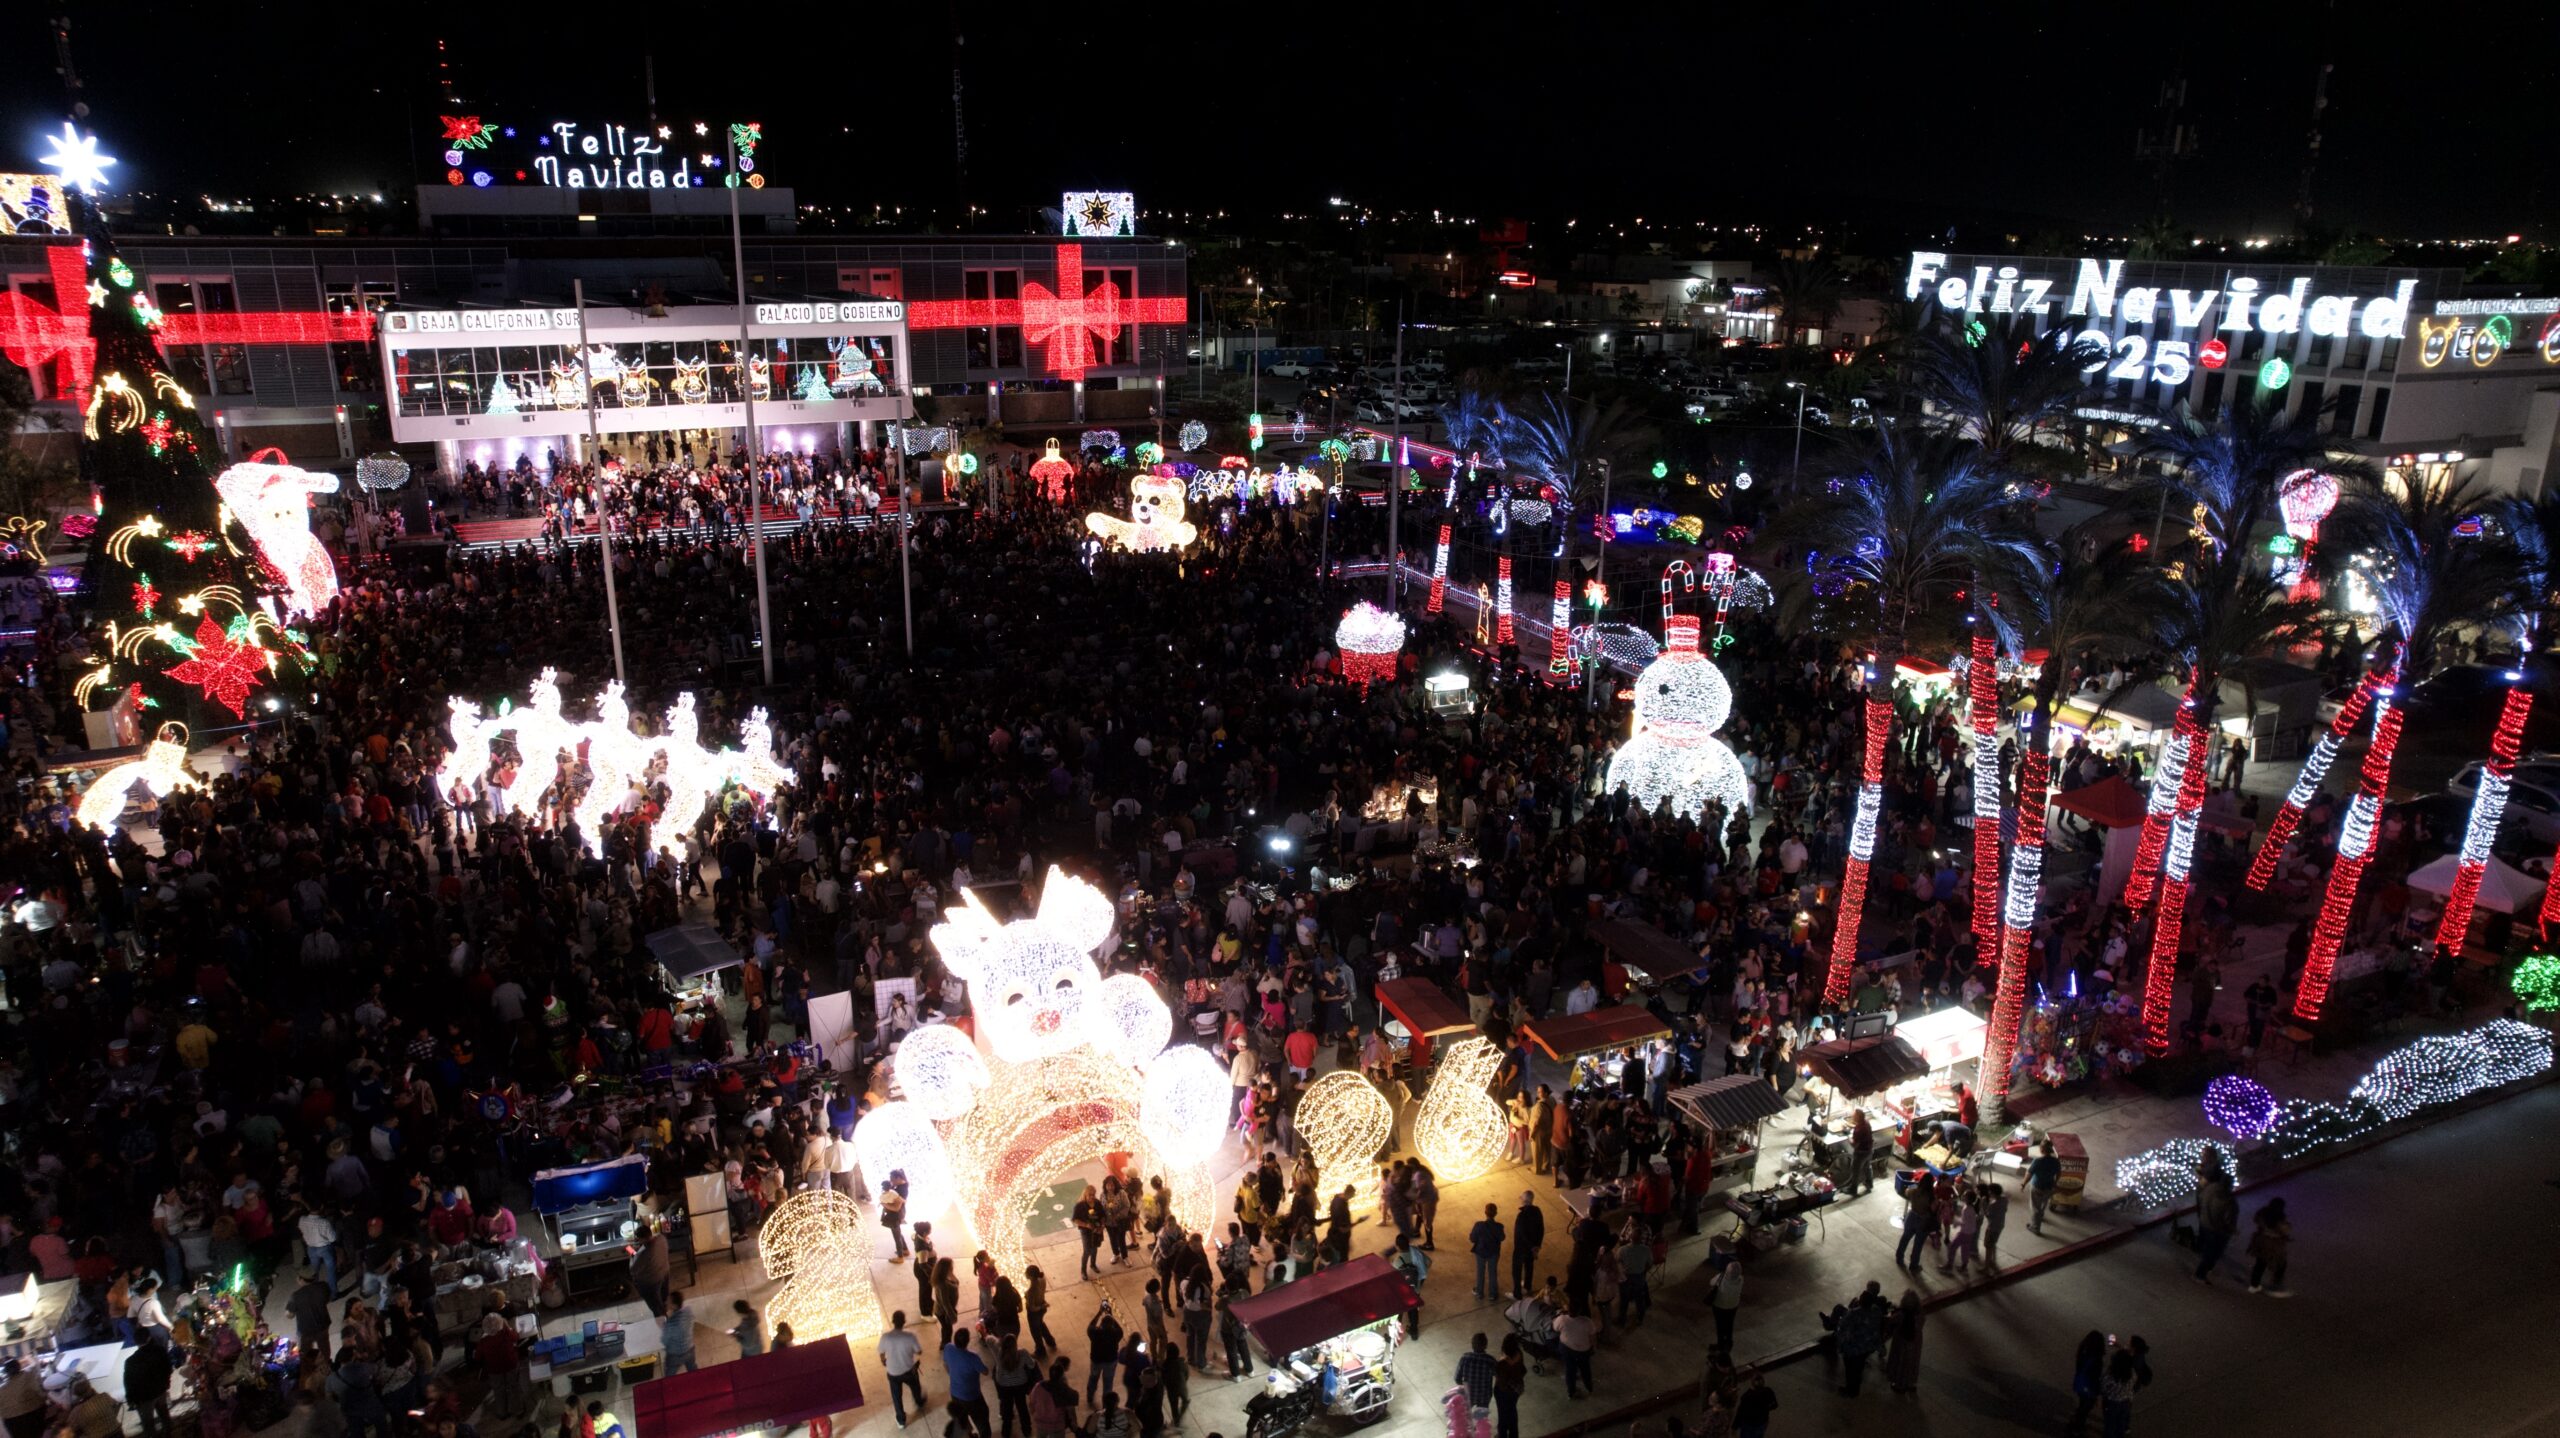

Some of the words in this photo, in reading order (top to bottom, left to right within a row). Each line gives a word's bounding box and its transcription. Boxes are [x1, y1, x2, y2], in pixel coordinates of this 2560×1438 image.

[552, 121, 663, 156] Feliz
[534, 156, 690, 188] Navidad
[1906, 251, 2053, 313] Feliz
[2069, 258, 2420, 339] Navidad
[421, 315, 455, 329] BAJA
[466, 313, 546, 328] CALIFORNIA
[556, 312, 581, 326] SUR
[760, 307, 810, 321] PALACIO
[820, 306, 834, 320] DE
[843, 304, 901, 319] GOBIERNO
